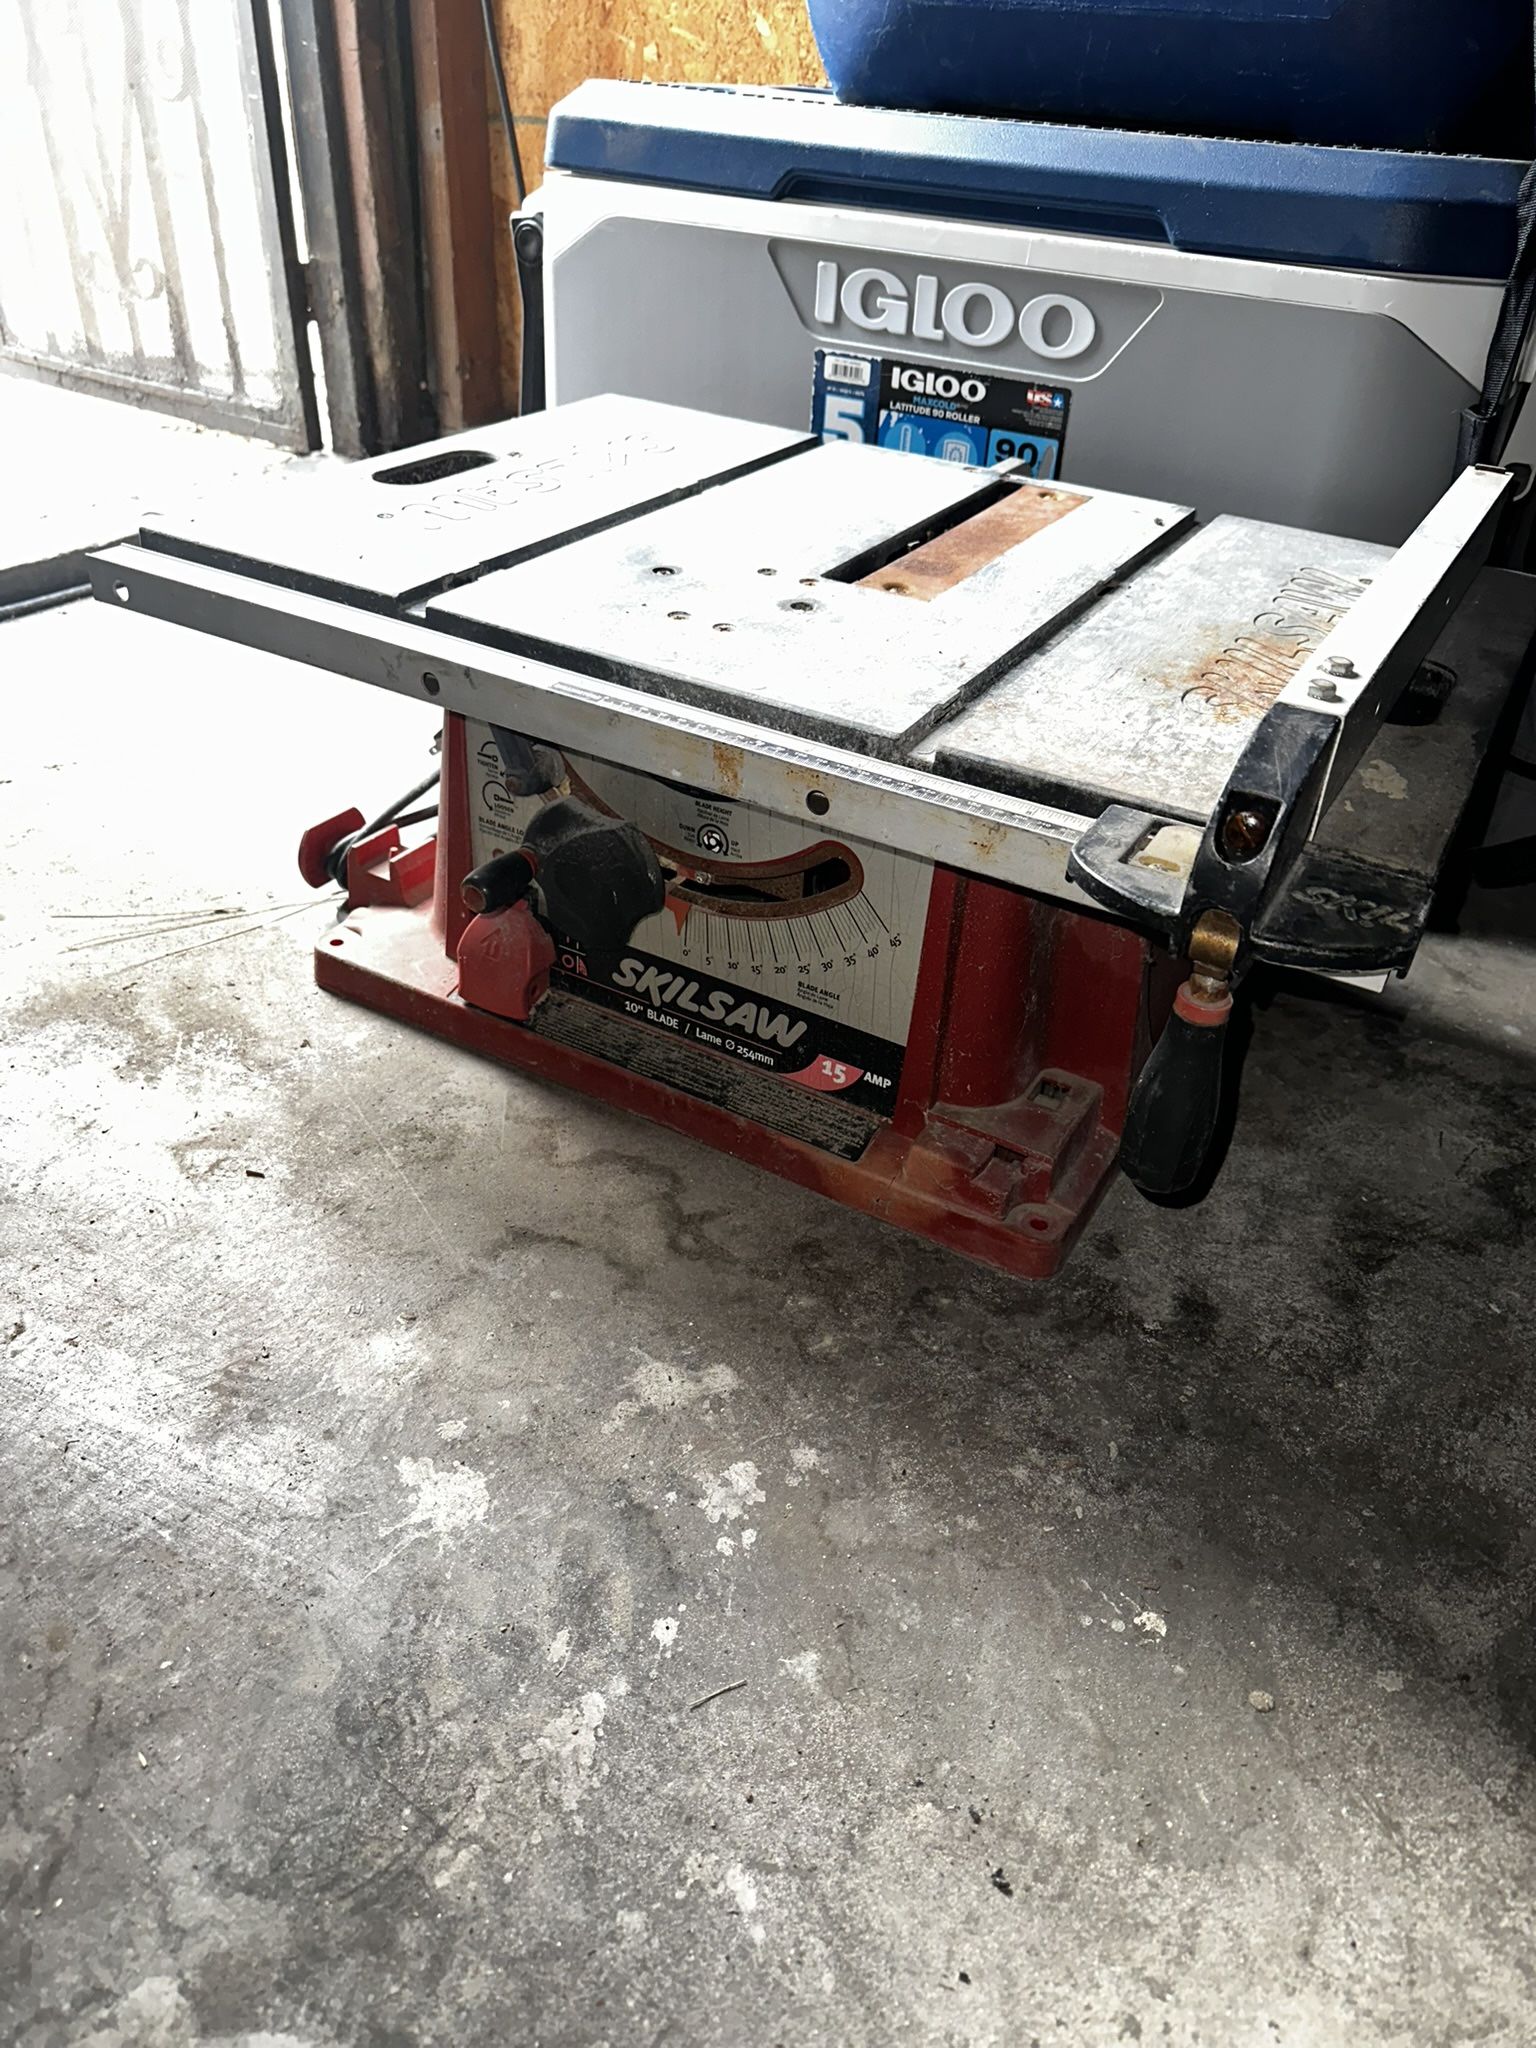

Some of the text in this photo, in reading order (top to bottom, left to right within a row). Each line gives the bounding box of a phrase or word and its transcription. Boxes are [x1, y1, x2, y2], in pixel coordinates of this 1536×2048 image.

[815, 260, 1096, 360] IGLOO
[890, 366, 987, 403] IGLOO
[889, 400, 981, 425] LATITUDE 90 ROLLER
[995, 438, 1038, 469] 90
[611, 957, 808, 1048] SKILSAW
[819, 988, 841, 1002] ANGLE
[647, 1008, 680, 1029] BLADE
[696, 1027, 722, 1046] Lame
[736, 1046, 775, 1067] 254mm
[821, 1059, 892, 1090] 15 AMP
